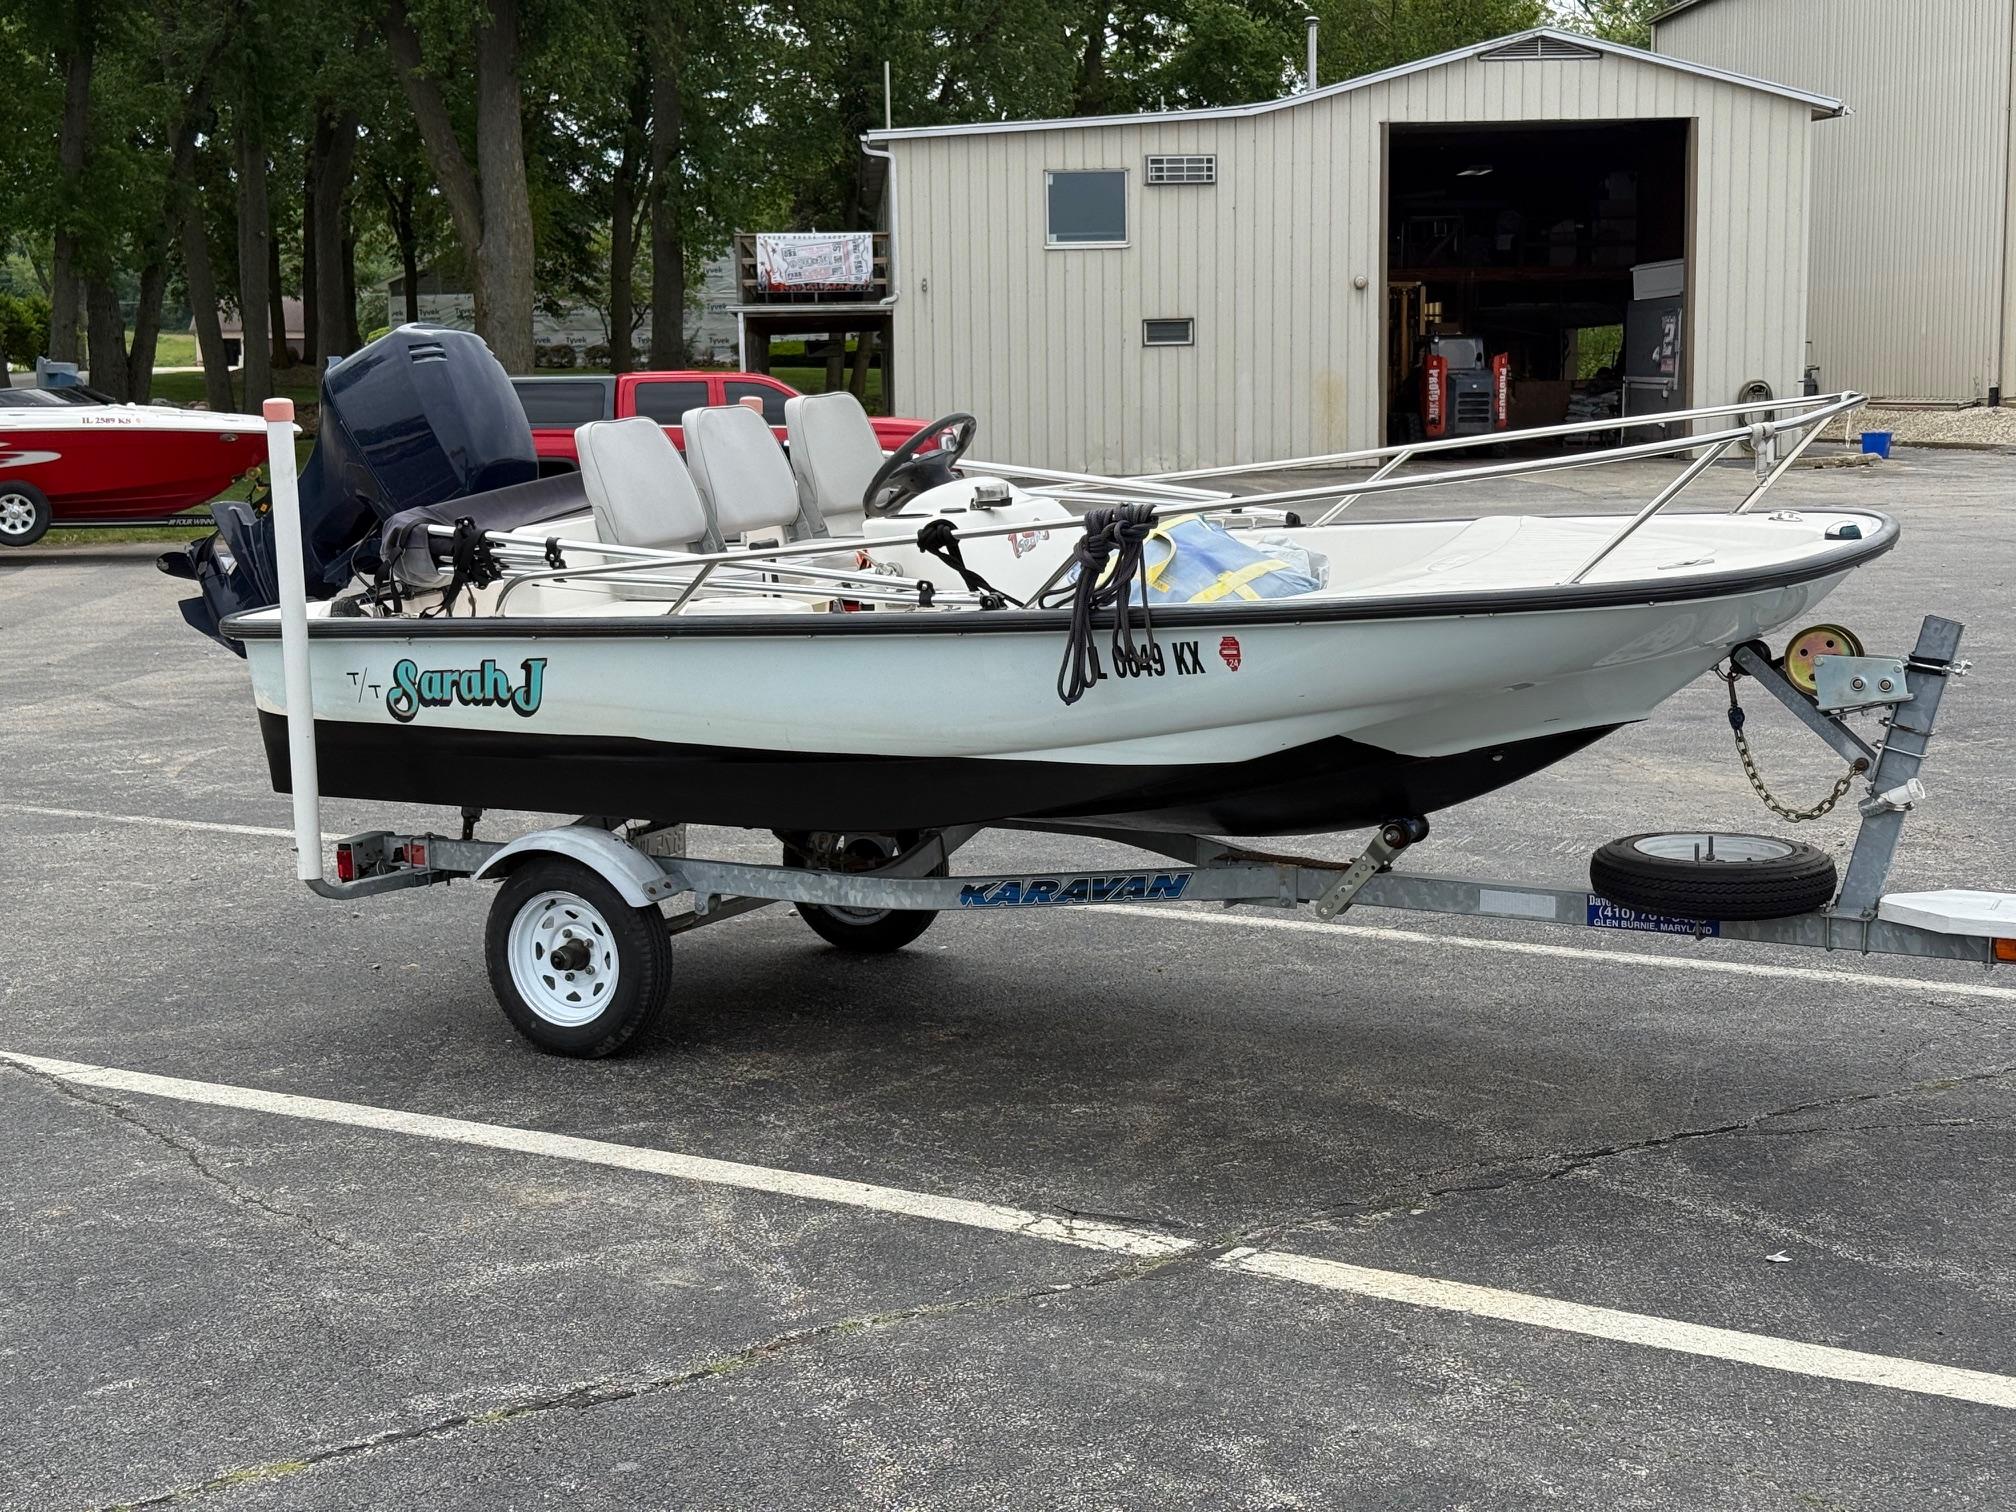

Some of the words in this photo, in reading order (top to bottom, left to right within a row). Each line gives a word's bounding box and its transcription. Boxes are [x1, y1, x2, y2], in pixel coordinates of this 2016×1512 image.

[1172, 641, 1206, 675] KX
[346, 667, 381, 703] T/T
[386, 659, 512, 723] Sarah
[511, 658, 547, 717] J
[959, 872, 1194, 907] KARAVAN
[1593, 918, 1619, 928] GLEN
[1598, 907, 1634, 921] (410)
